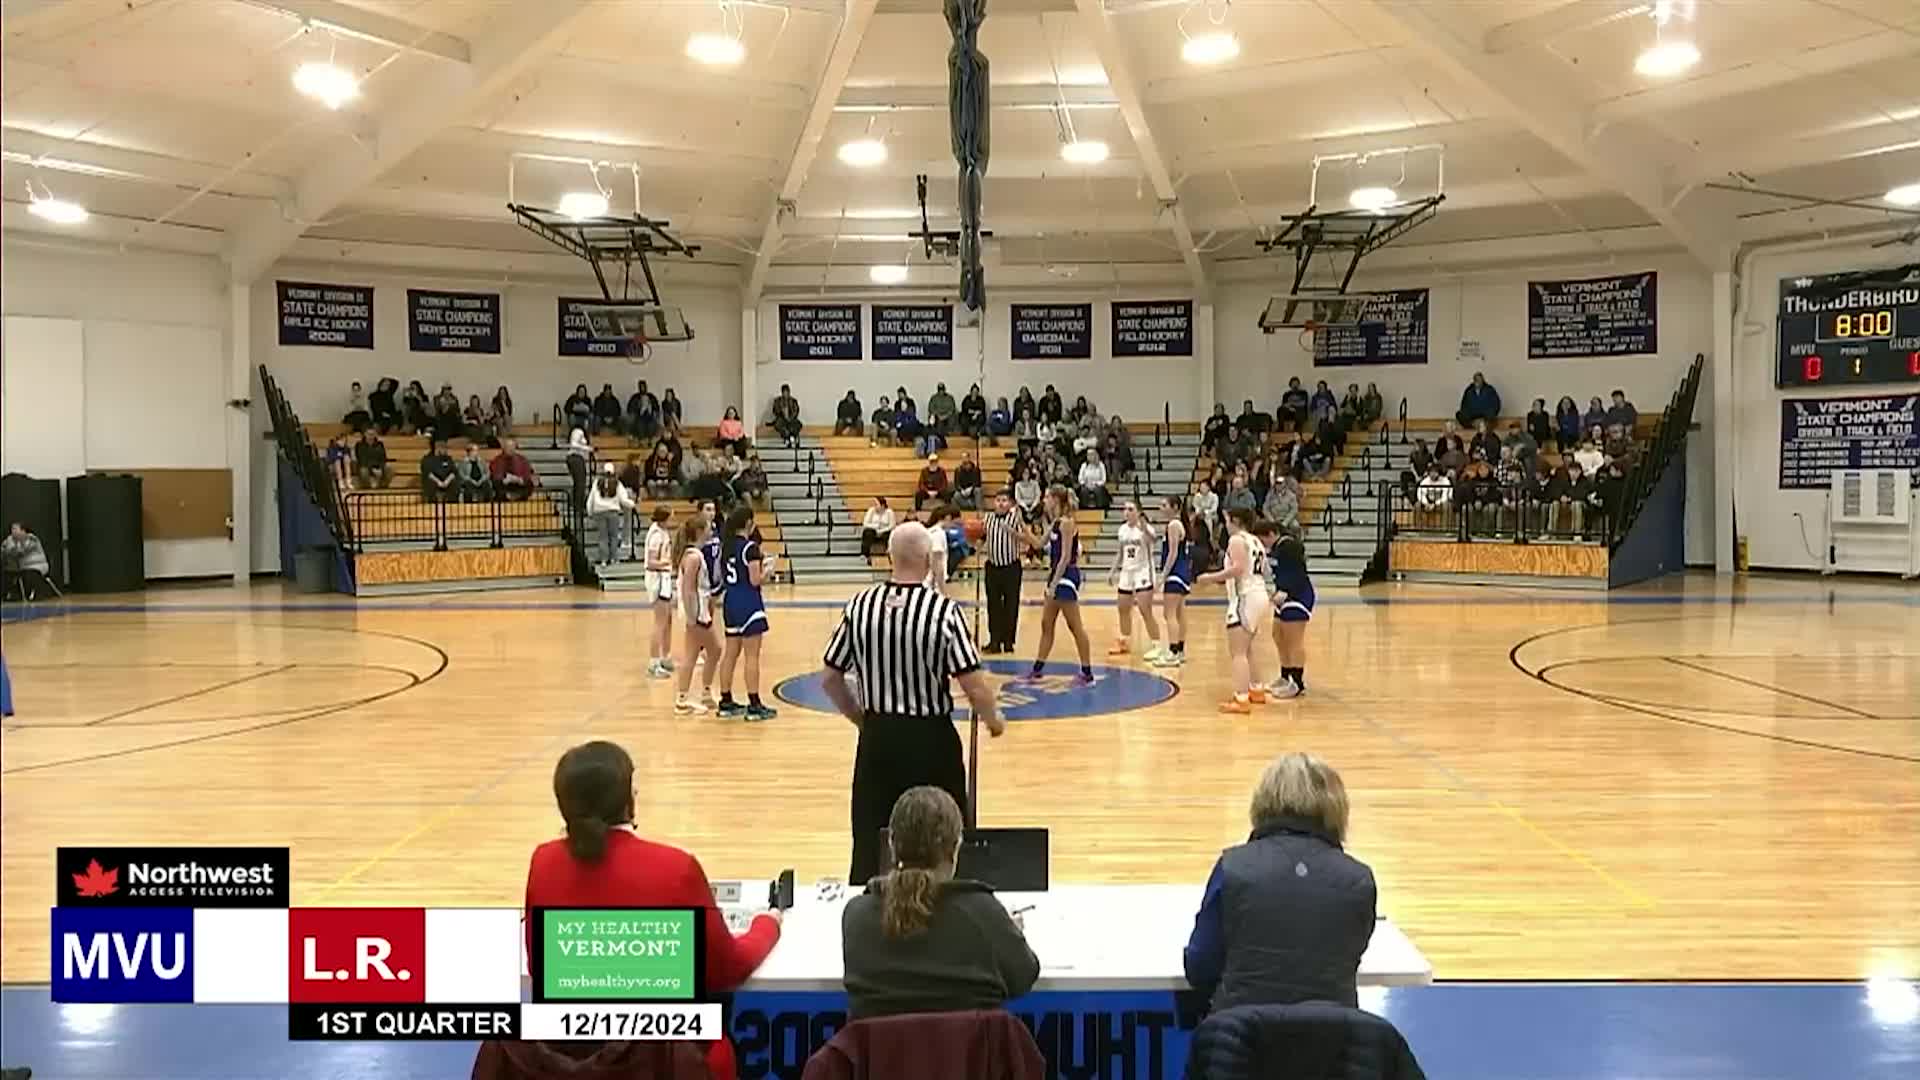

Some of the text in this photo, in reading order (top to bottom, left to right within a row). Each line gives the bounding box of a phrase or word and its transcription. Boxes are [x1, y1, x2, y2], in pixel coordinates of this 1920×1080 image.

[1561, 280, 1621, 293] VERMONT
[288, 288, 321, 300] VERMONT
[1542, 288, 1642, 304] STATE CHAMPIONS
[283, 301, 369, 318] STATE CHAMPIONS
[416, 309, 494, 324] STATE CHAMPIONS
[331, 319, 368, 330] HOCKEY
[418, 323, 491, 336] BOYS SOCCER
[785, 321, 857, 333] STATE CHAMPIONS
[877, 321, 948, 333] STATE CHAMPIONS
[1016, 319, 1086, 331] STATE CHAMPIONS
[1117, 316, 1188, 331] STATE CHAMPIONS
[1836, 312, 1891, 337] 8:00
[440, 337, 471, 348] 2010
[786, 335, 854, 344] FIELD HOCKEY
[875, 335, 948, 344] BOYS BASKETBALL
[1022, 332, 1080, 343] BASEBALL
[1118, 331, 1184, 342] FIELD HOCKEY
[587, 343, 617, 354] 2010
[1790, 344, 1816, 355] MVU
[1806, 356, 1821, 380] 0
[1854, 358, 1862, 374] 1
[1818, 399, 1892, 412] VERMONT
[1797, 411, 1914, 425] STATE CHAMPIONS
[1847, 425, 1874, 436] TRACK
[1886, 423, 1912, 436] FIELD
[726, 557, 738, 584] 5
